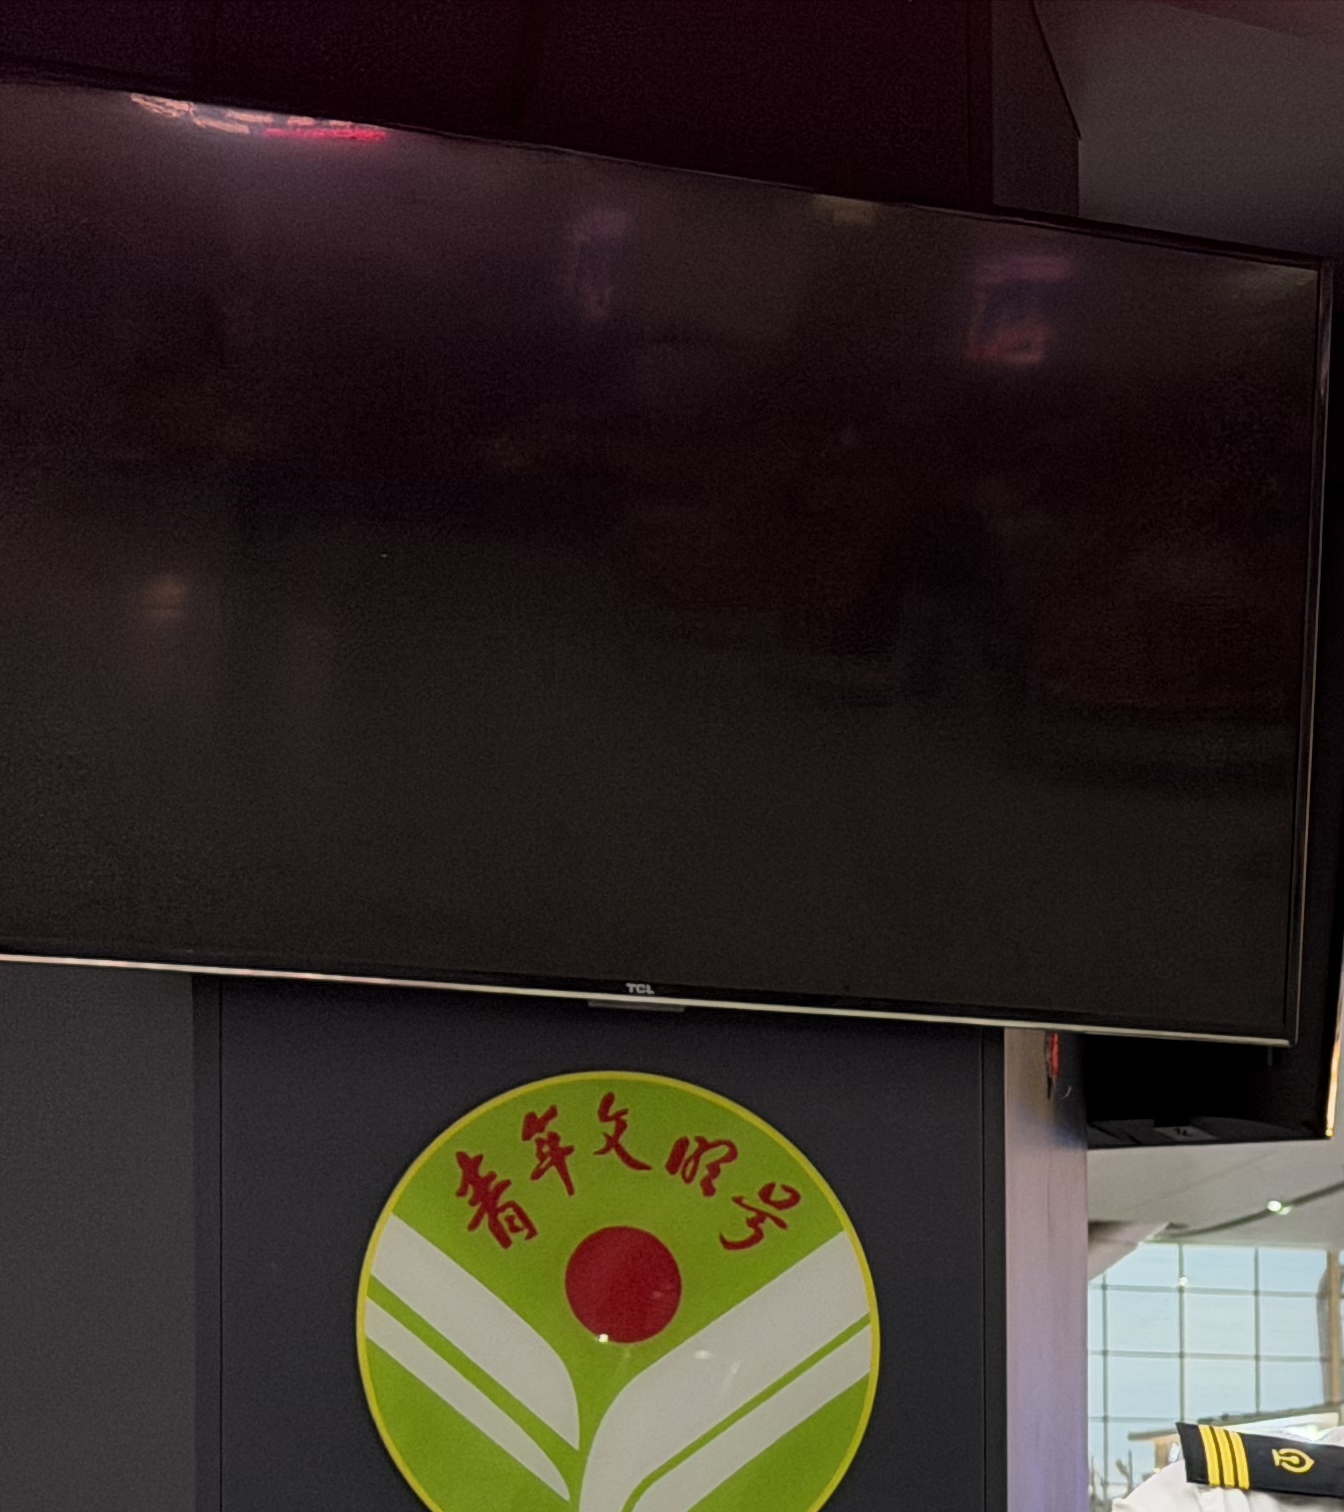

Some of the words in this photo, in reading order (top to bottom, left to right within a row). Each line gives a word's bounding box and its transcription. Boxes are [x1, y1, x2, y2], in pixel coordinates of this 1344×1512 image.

[625, 982, 655, 995] TCL
[455, 1092, 801, 1251] 青年文明号
